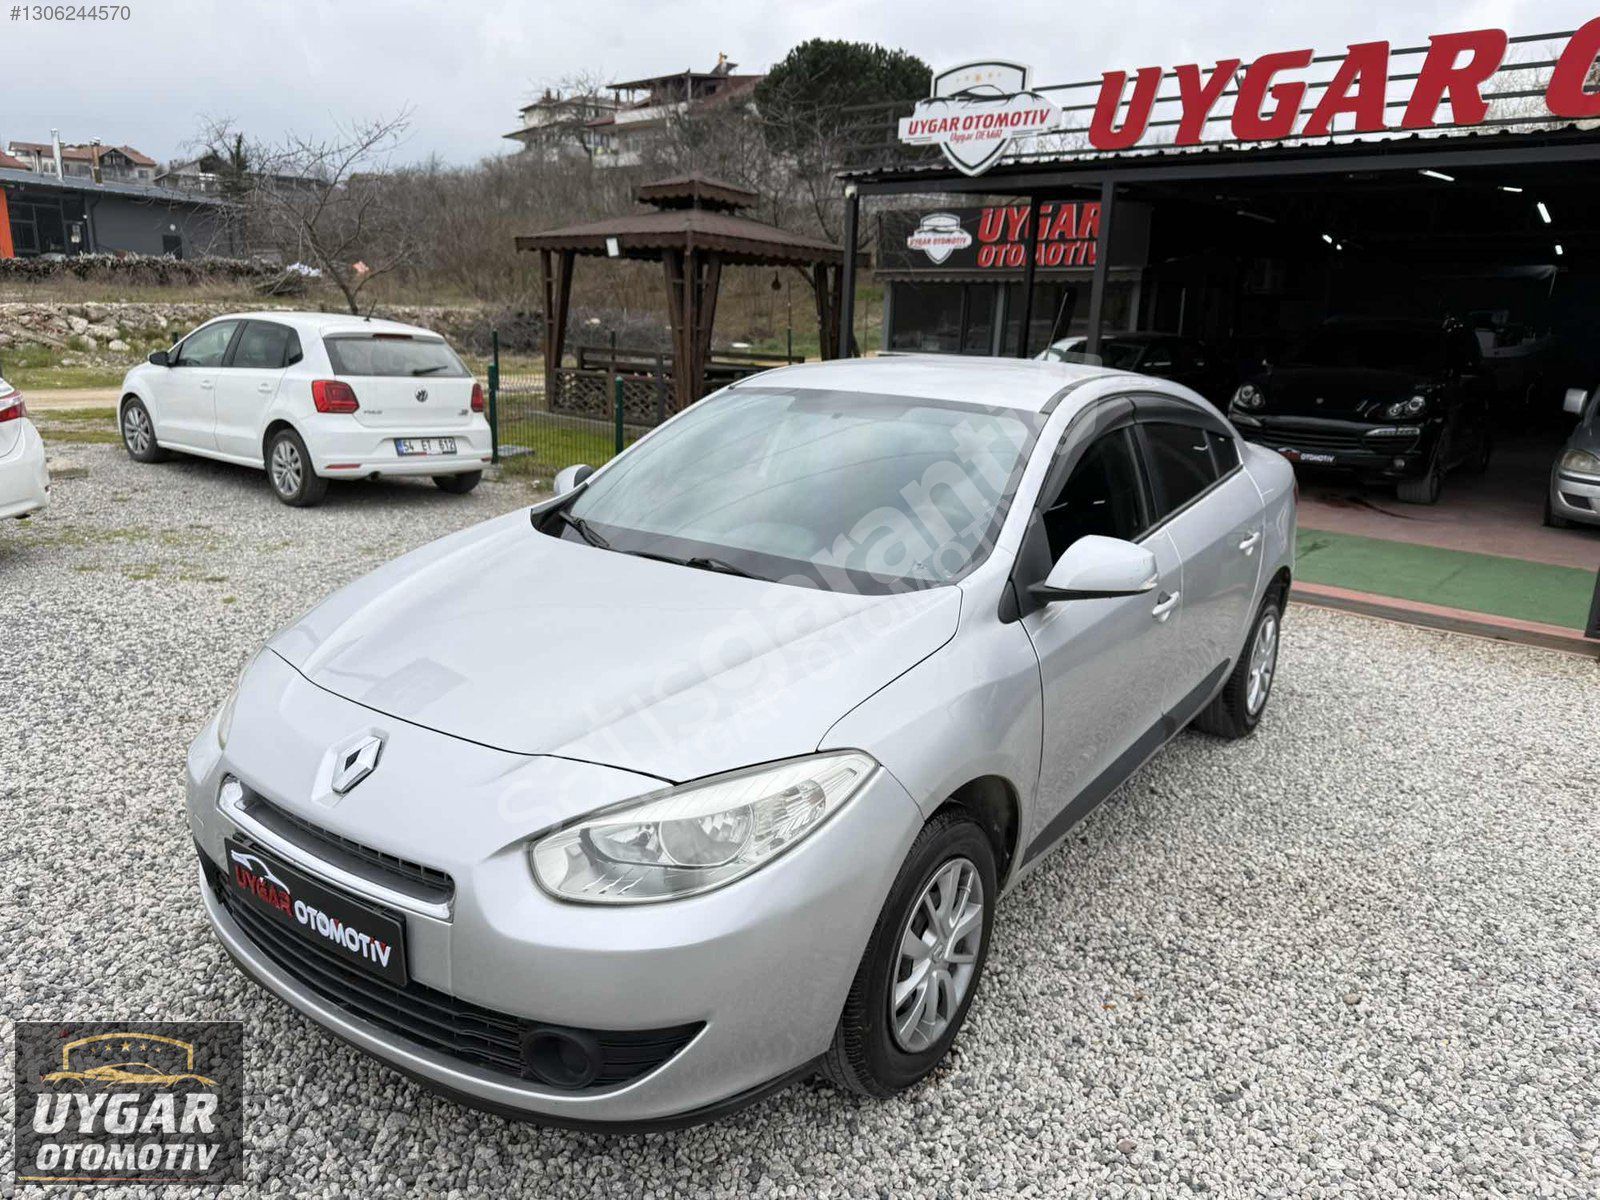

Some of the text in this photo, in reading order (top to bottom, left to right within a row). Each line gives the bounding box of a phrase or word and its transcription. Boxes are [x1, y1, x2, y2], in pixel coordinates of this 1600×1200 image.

[1089, 28, 1508, 150] UYGAR
[908, 108, 1050, 136] UYGAR OTOMOTIV
[234, 865, 294, 920] UYGAR
